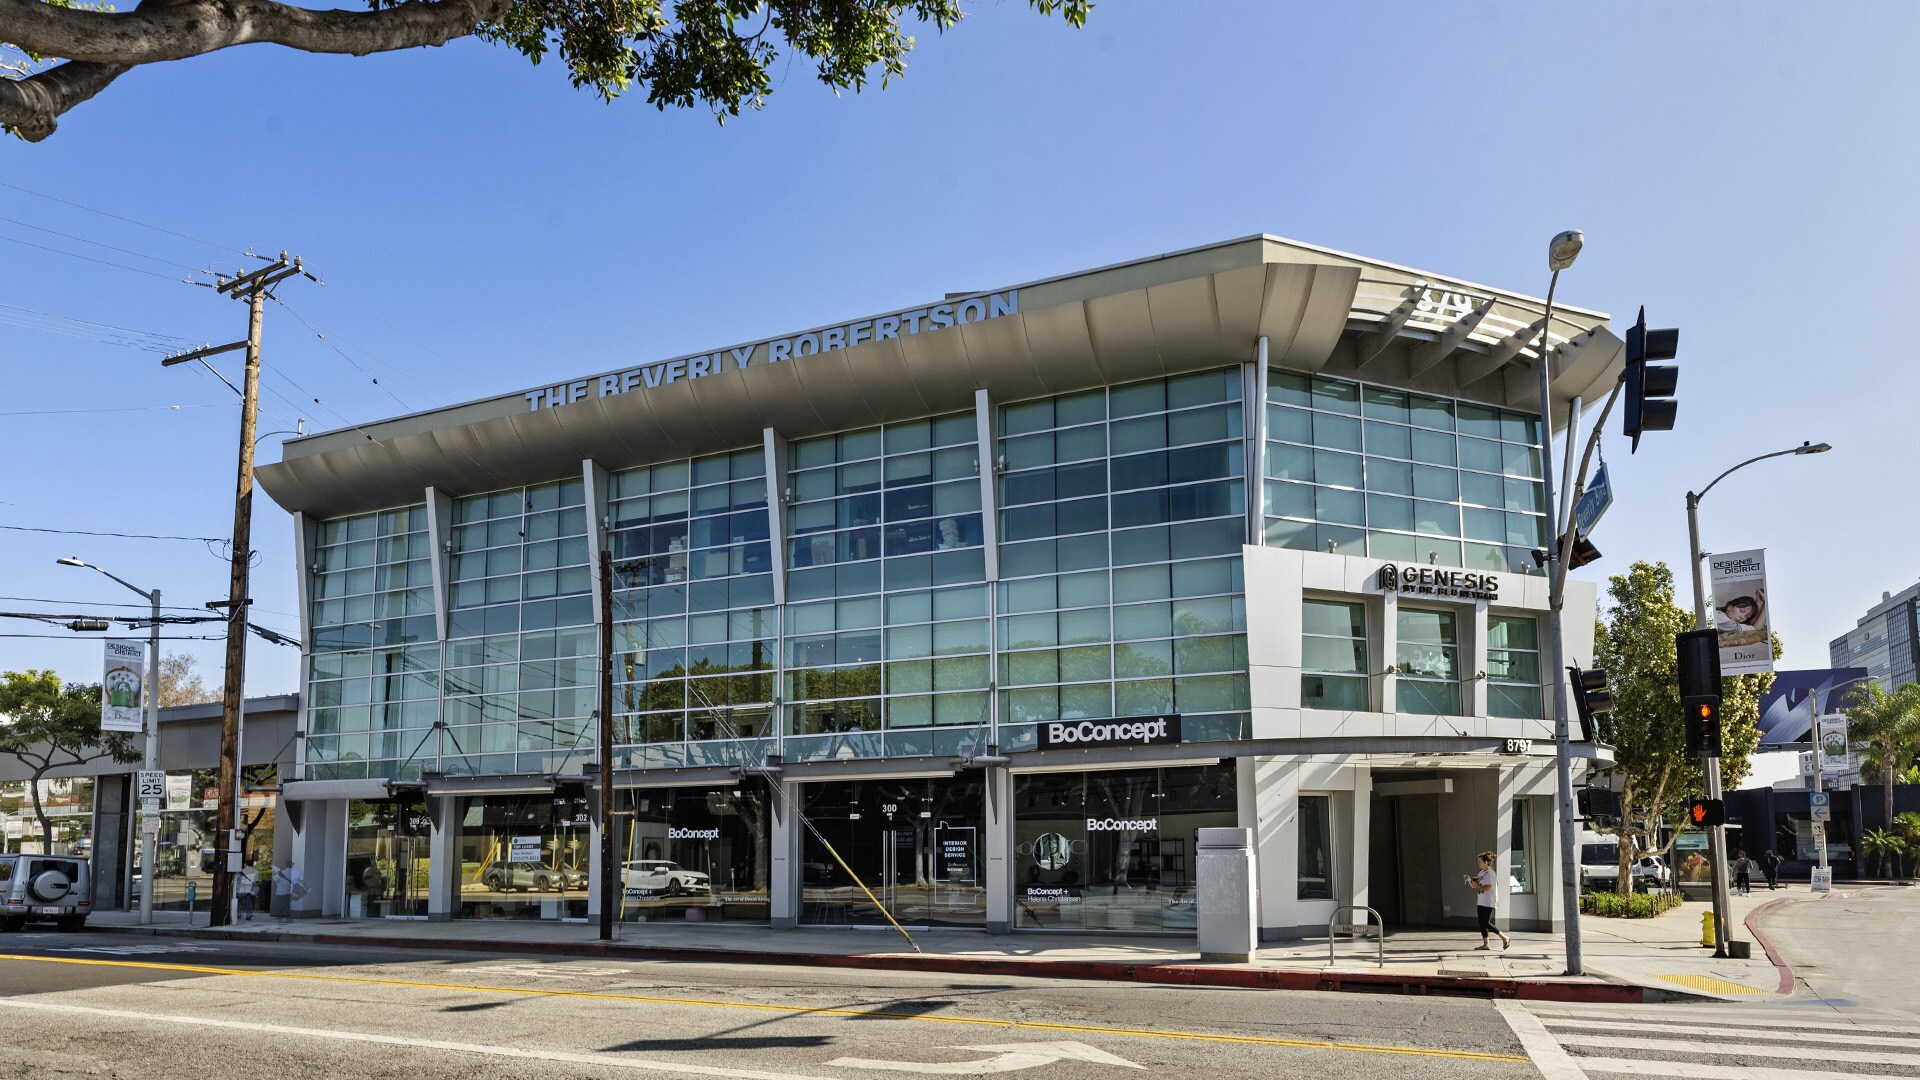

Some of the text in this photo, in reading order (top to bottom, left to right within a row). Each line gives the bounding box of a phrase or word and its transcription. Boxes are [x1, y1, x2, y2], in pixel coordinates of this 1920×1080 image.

[525, 380, 588, 411] THE
[769, 289, 1019, 364] ROBERTSON
[1713, 559, 1746, 569] DESIGN
[1725, 562, 1761, 574] DISTRICT
[1402, 566, 1499, 592] GENESIS
[1402, 584, 1416, 593] BY
[1419, 586, 1436, 595] DR.
[1438, 588, 1457, 597] BEN
[1734, 652, 1755, 660] Dior
[1048, 718, 1167, 744] BoConcept
[1507, 739, 1532, 752] 8797
[141, 784, 163, 795] 25
[882, 804, 898, 812] 300
[575, 813, 588, 821] 302
[1087, 818, 1157, 833] BoConcept
[668, 827, 720, 841] BoConcept
[1027, 888, 1063, 896] BoConcept
